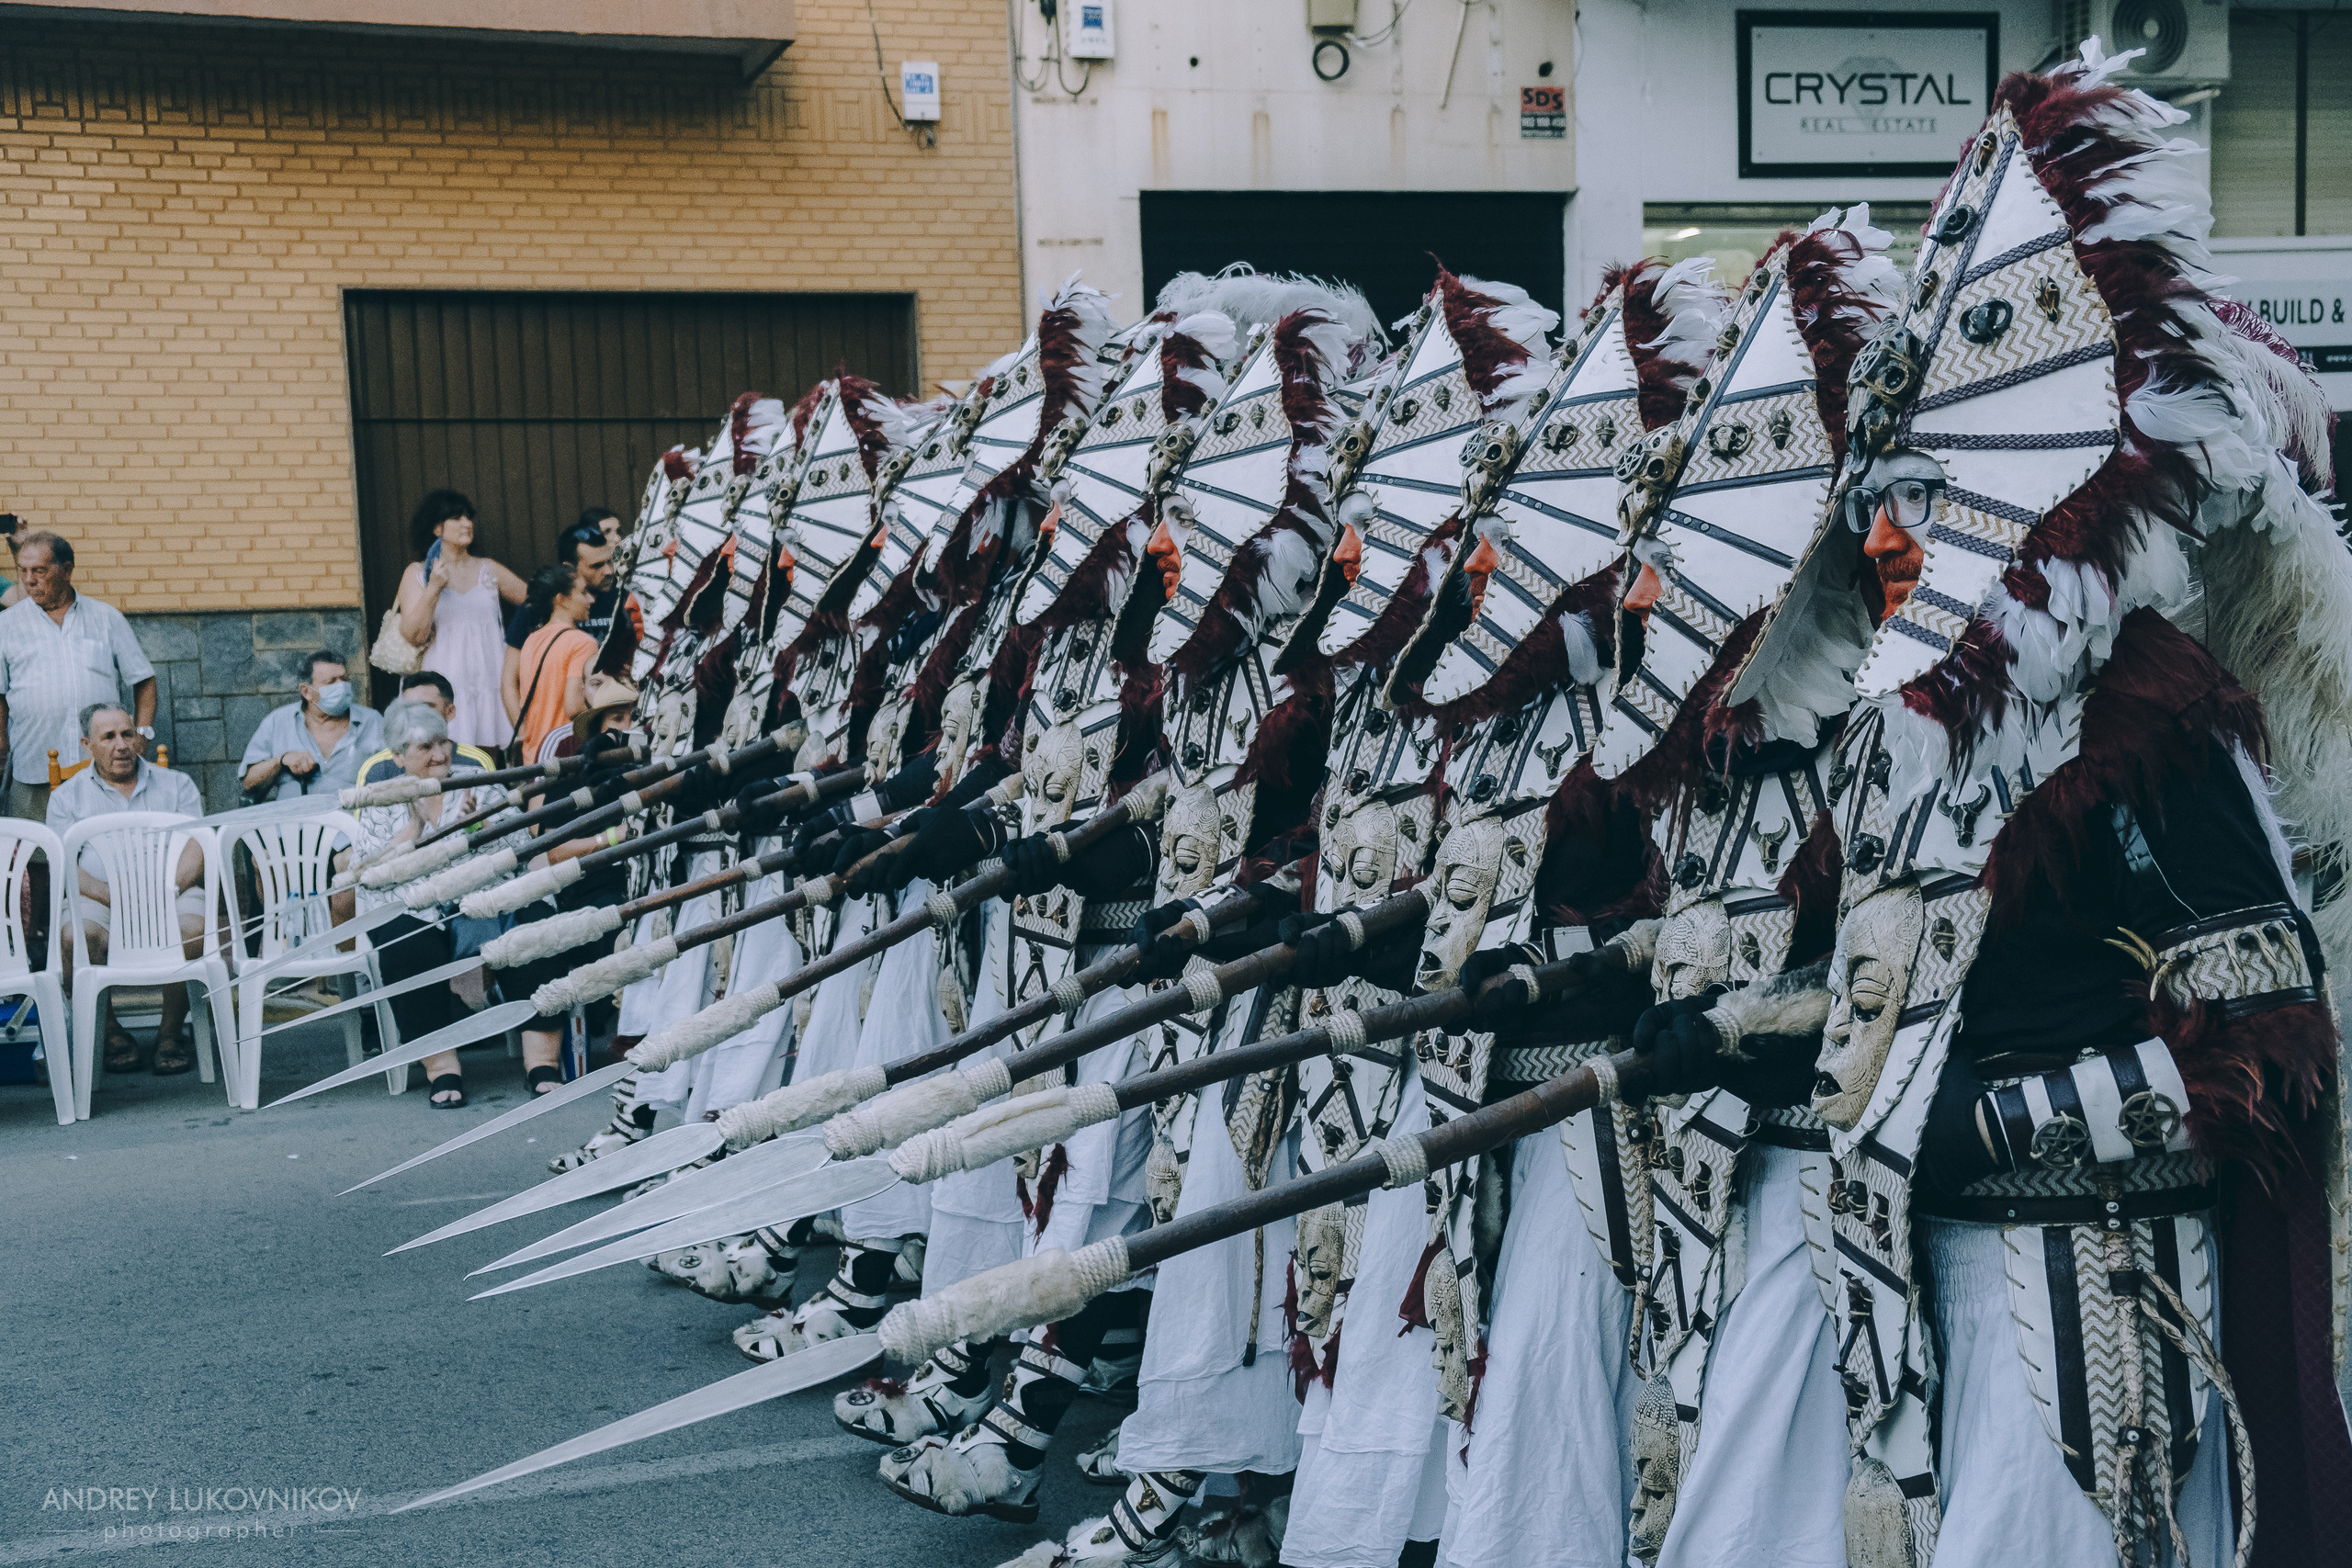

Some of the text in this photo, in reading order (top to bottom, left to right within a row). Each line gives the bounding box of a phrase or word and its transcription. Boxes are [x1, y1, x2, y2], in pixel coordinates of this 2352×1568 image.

[1522, 87, 1564, 110] SDS
[1765, 72, 1972, 105] CRYSTAL
[1800, 118, 1938, 133] REAL ESTATE
[2259, 298, 2345, 323] BUILD &
